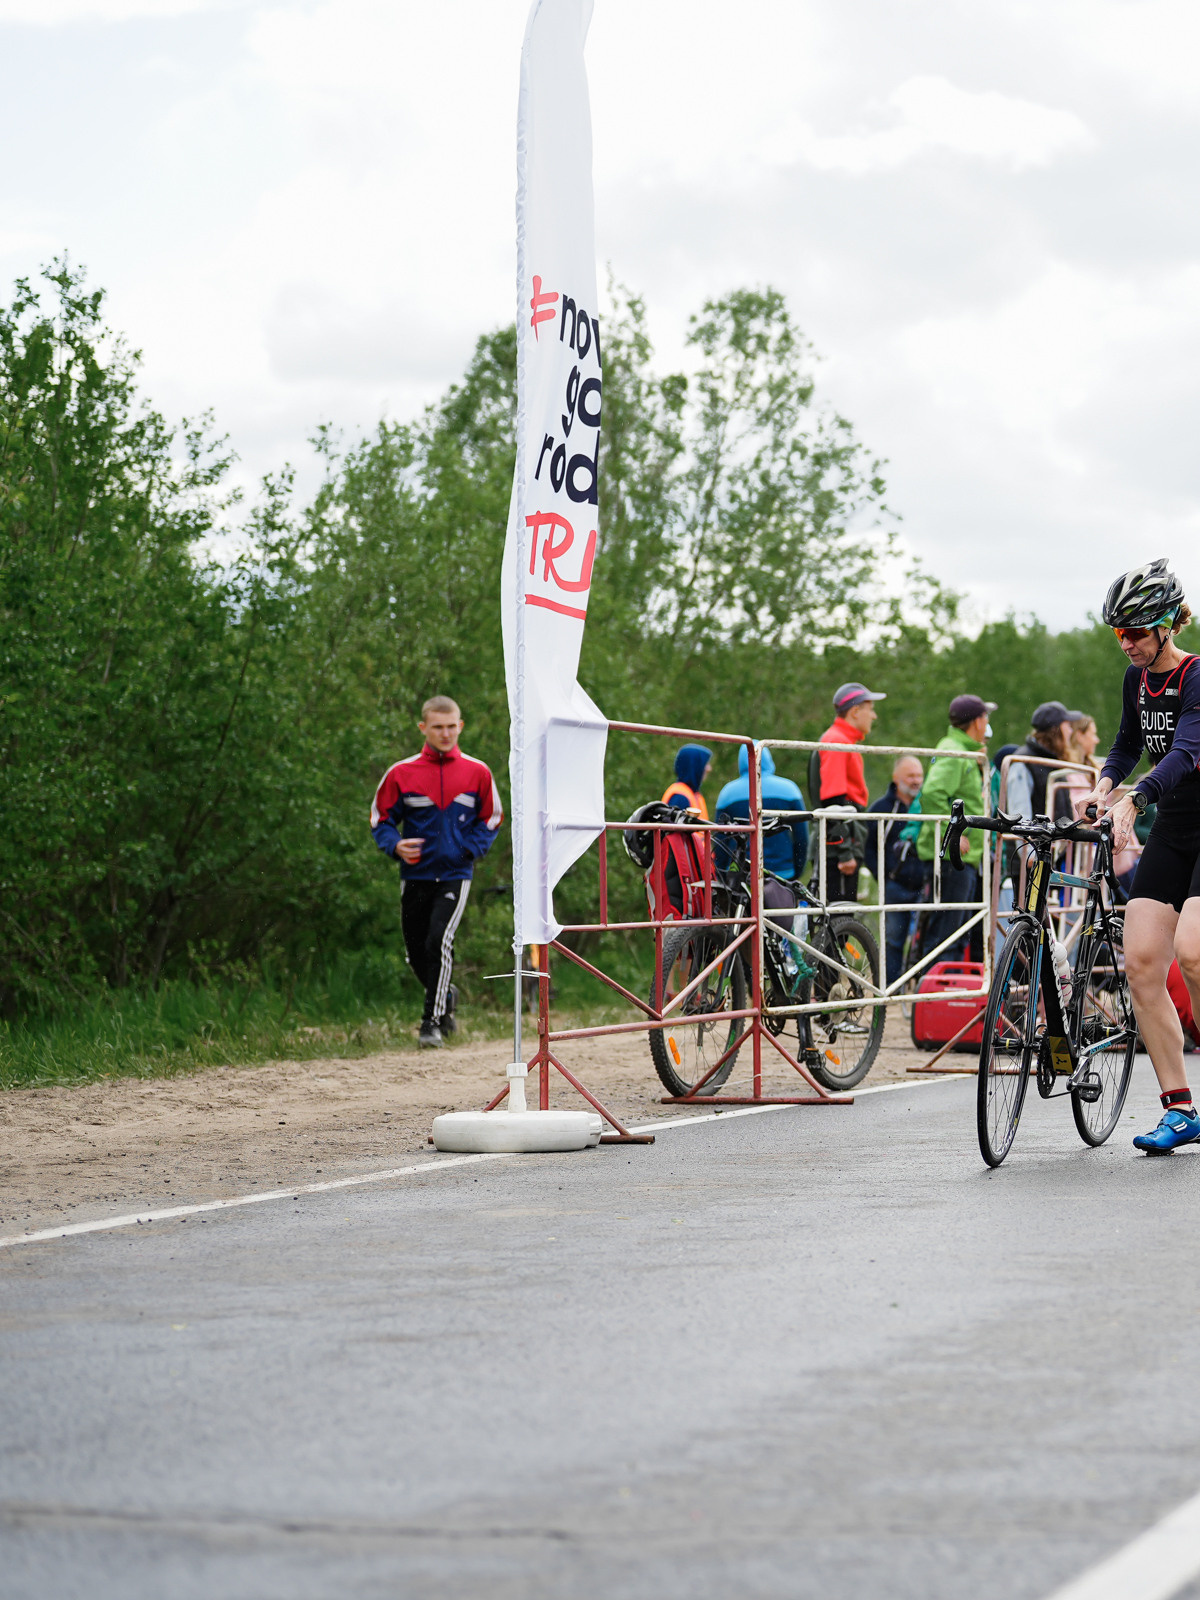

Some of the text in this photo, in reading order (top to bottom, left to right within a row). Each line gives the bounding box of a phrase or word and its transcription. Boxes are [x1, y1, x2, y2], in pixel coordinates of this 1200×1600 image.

[561, 365, 601, 438] go
[534, 431, 599, 506] rod
[1141, 710, 1175, 731] GUIDE
